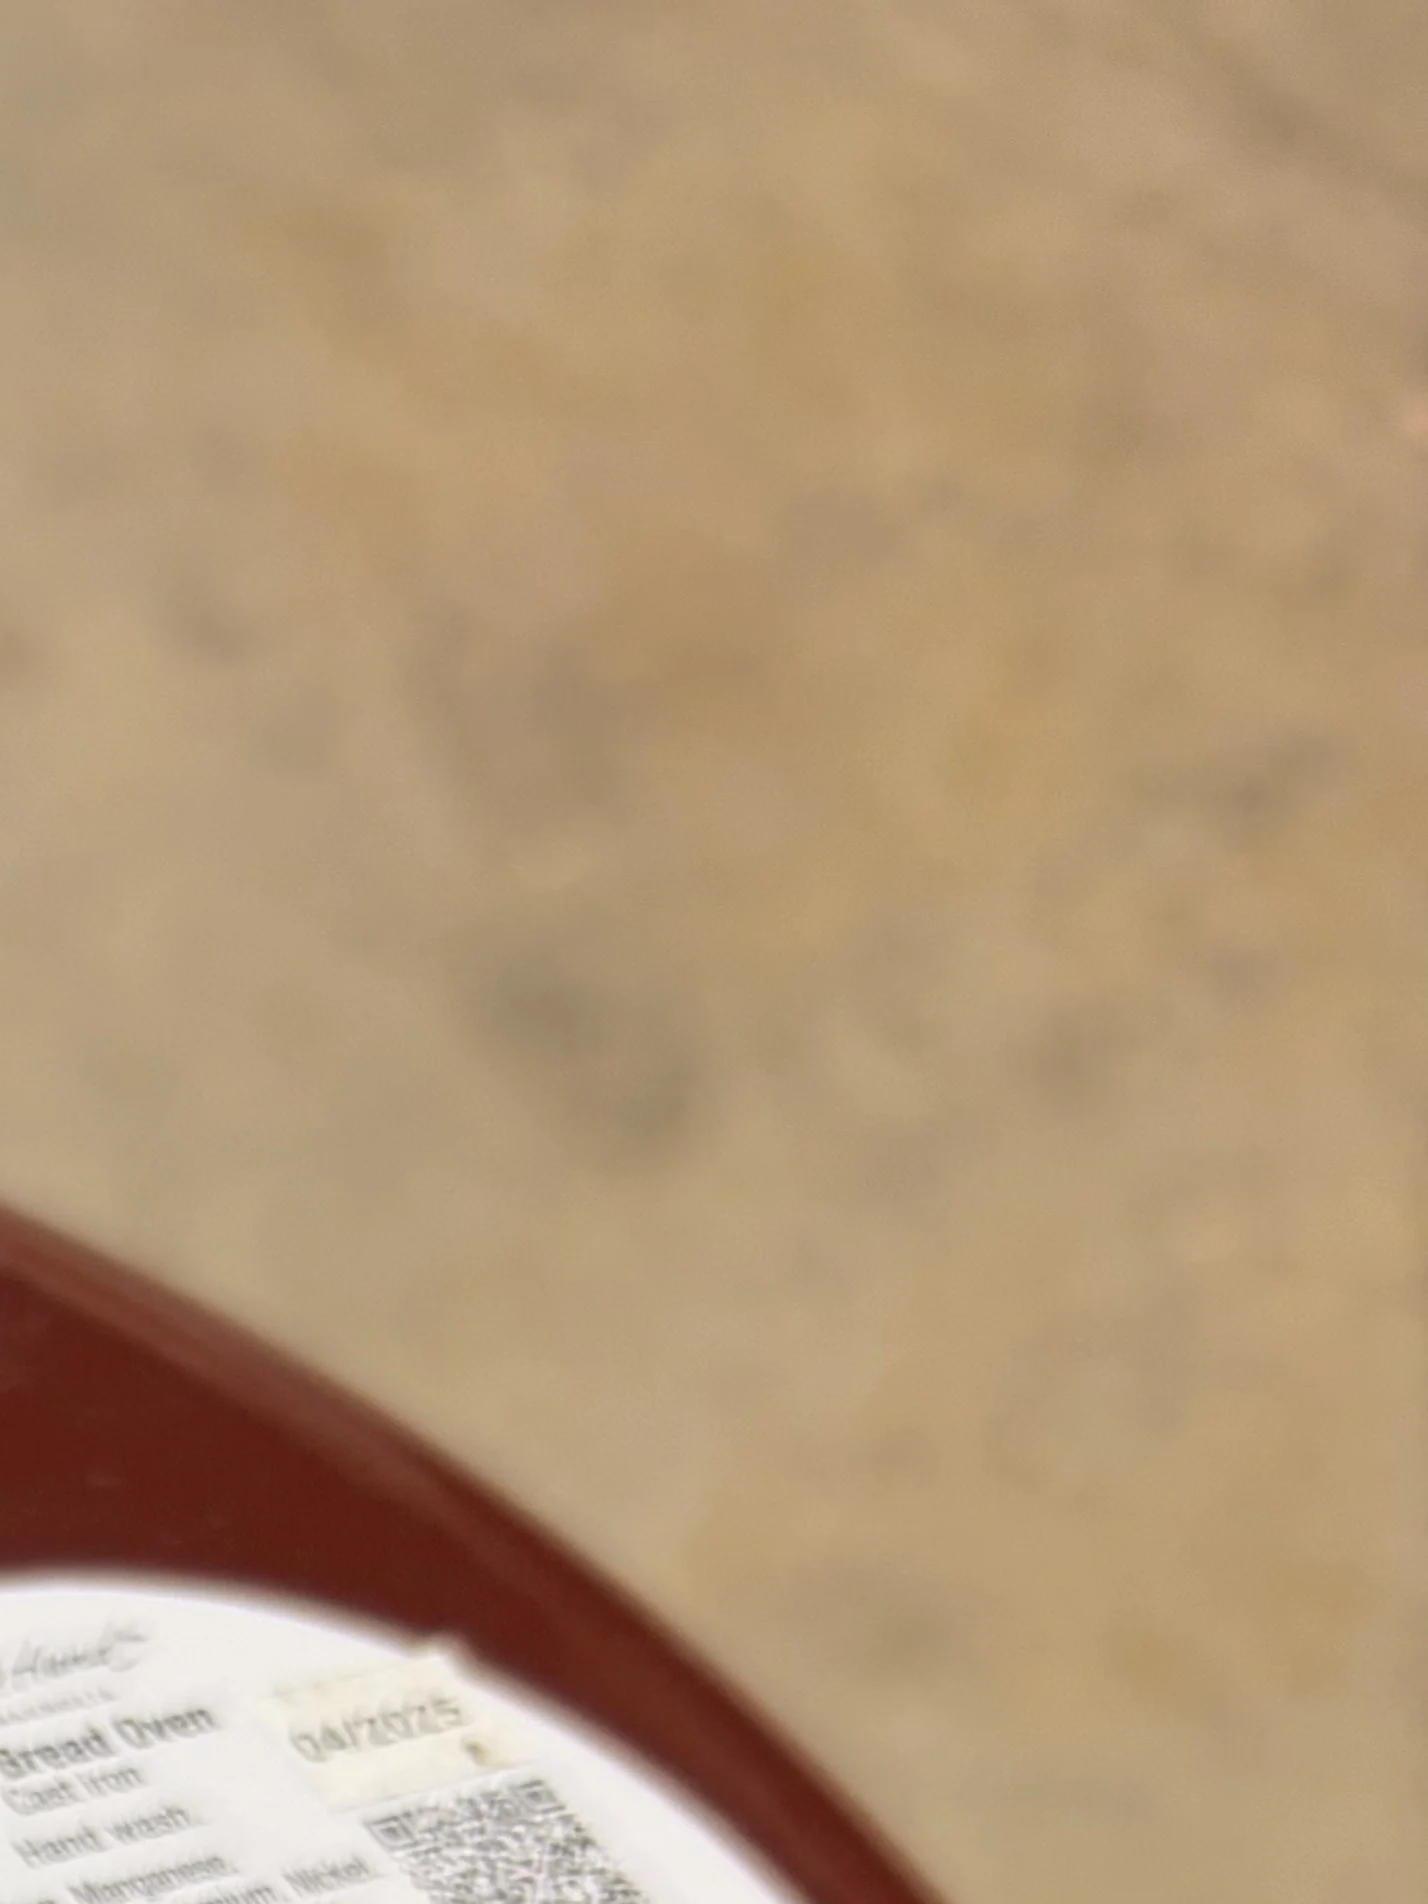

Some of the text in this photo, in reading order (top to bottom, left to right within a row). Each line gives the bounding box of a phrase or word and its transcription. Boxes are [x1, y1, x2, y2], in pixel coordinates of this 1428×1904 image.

[110, 1706, 221, 1751] Oven
[1, 1777, 81, 1817] Cast
[11, 1822, 110, 1869] Hand
